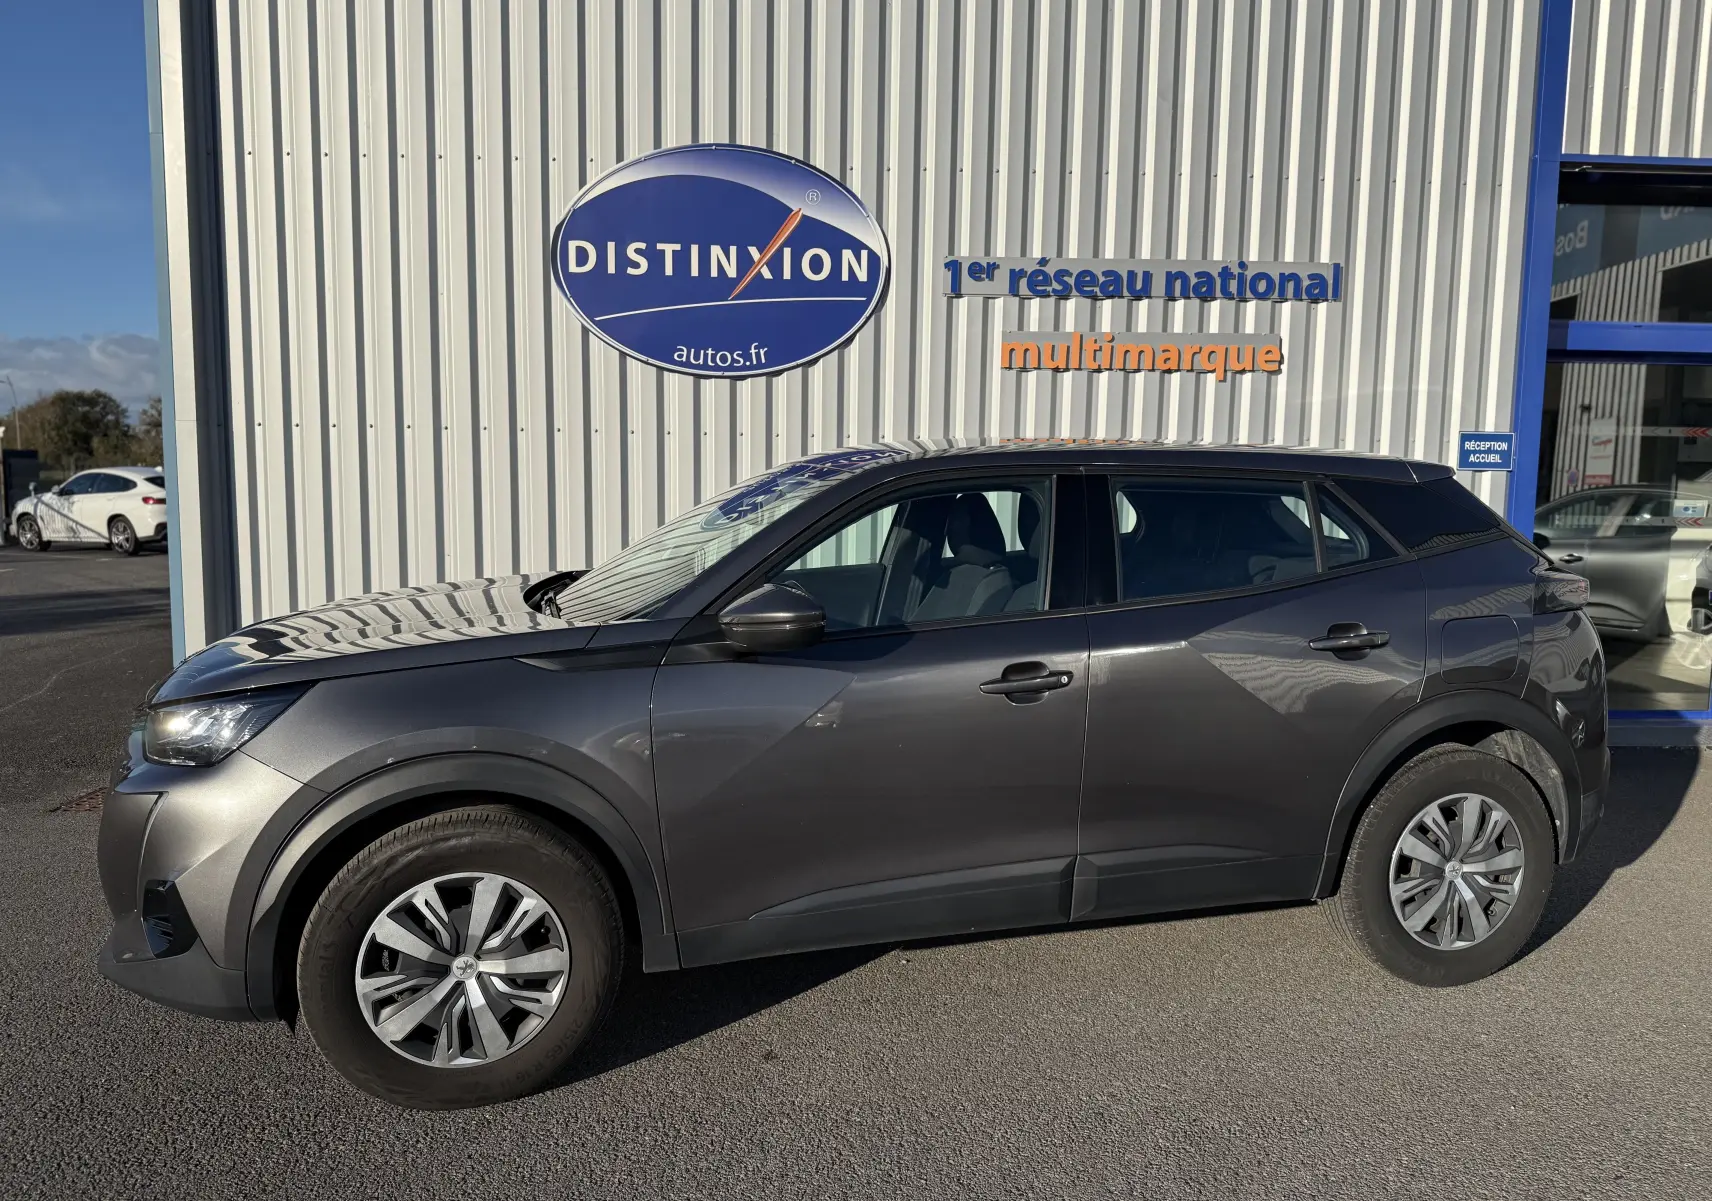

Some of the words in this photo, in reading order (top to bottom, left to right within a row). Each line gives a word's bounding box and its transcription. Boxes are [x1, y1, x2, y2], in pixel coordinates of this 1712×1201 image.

[567, 239, 869, 283] DISTINXION
[944, 259, 1000, 294] 1er
[1009, 257, 1152, 297] réseau
[1165, 260, 1341, 300] national
[673, 342, 768, 367] autos.fr
[1001, 332, 1282, 381] multimarque
[1464, 440, 1508, 451] RÉCEPTION
[1468, 453, 1503, 463] ACCUEIL
